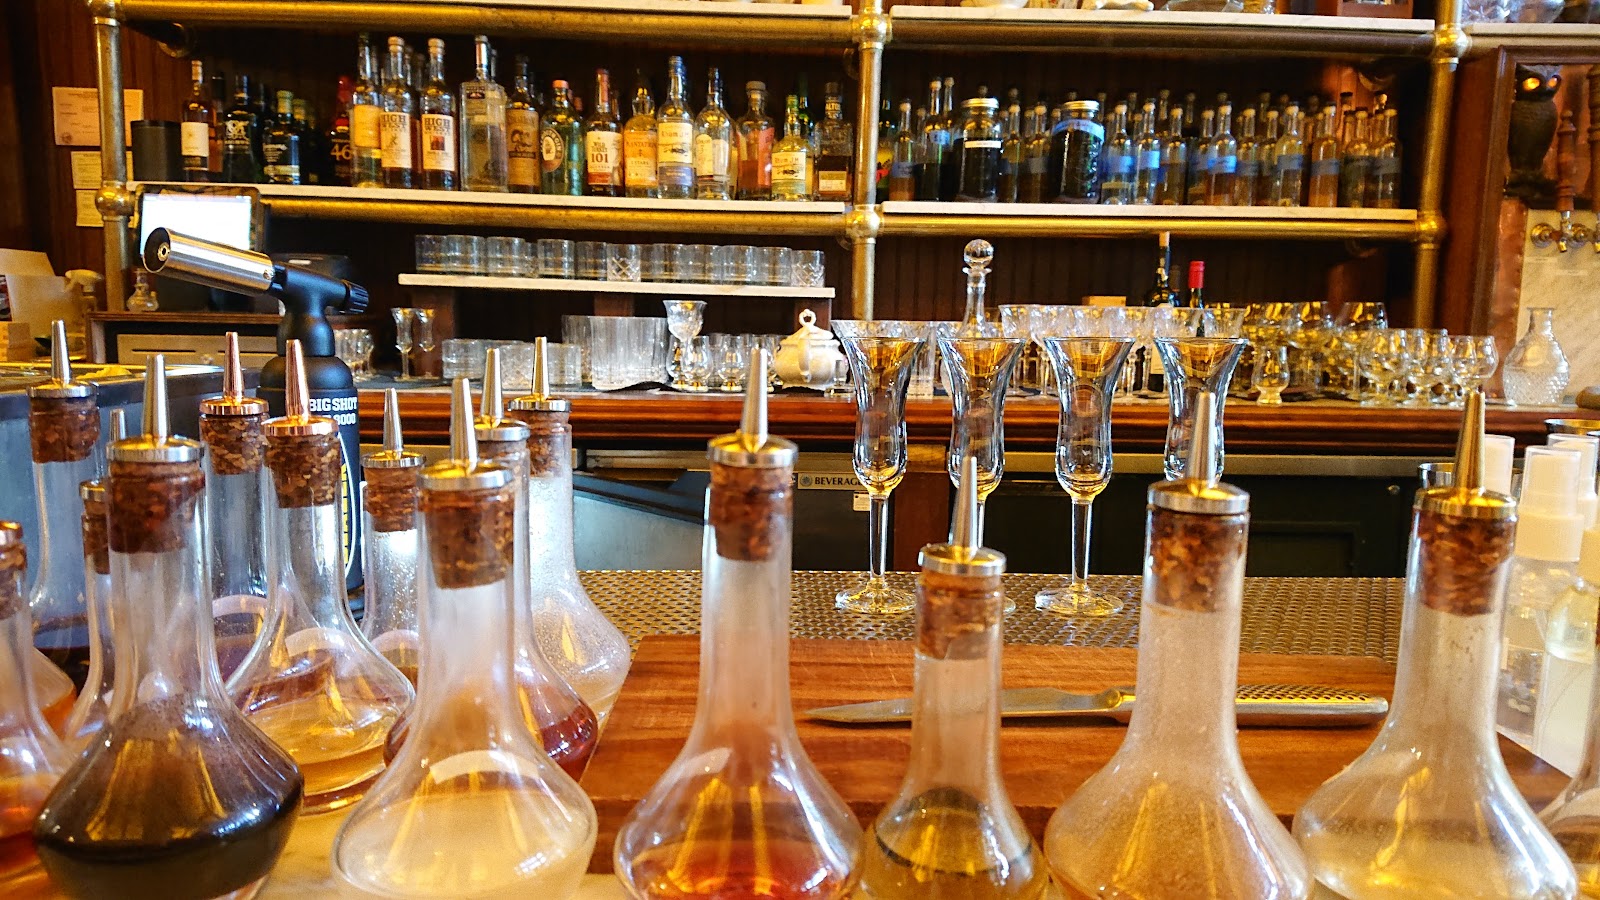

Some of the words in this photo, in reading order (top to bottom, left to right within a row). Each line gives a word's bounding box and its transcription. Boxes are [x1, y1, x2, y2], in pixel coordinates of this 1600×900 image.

[424, 118, 450, 127] HIGH
[331, 144, 352, 160] 46
[591, 153, 609, 163] 101
[309, 398, 331, 412] BIG
[332, 397, 358, 411] SHOT
